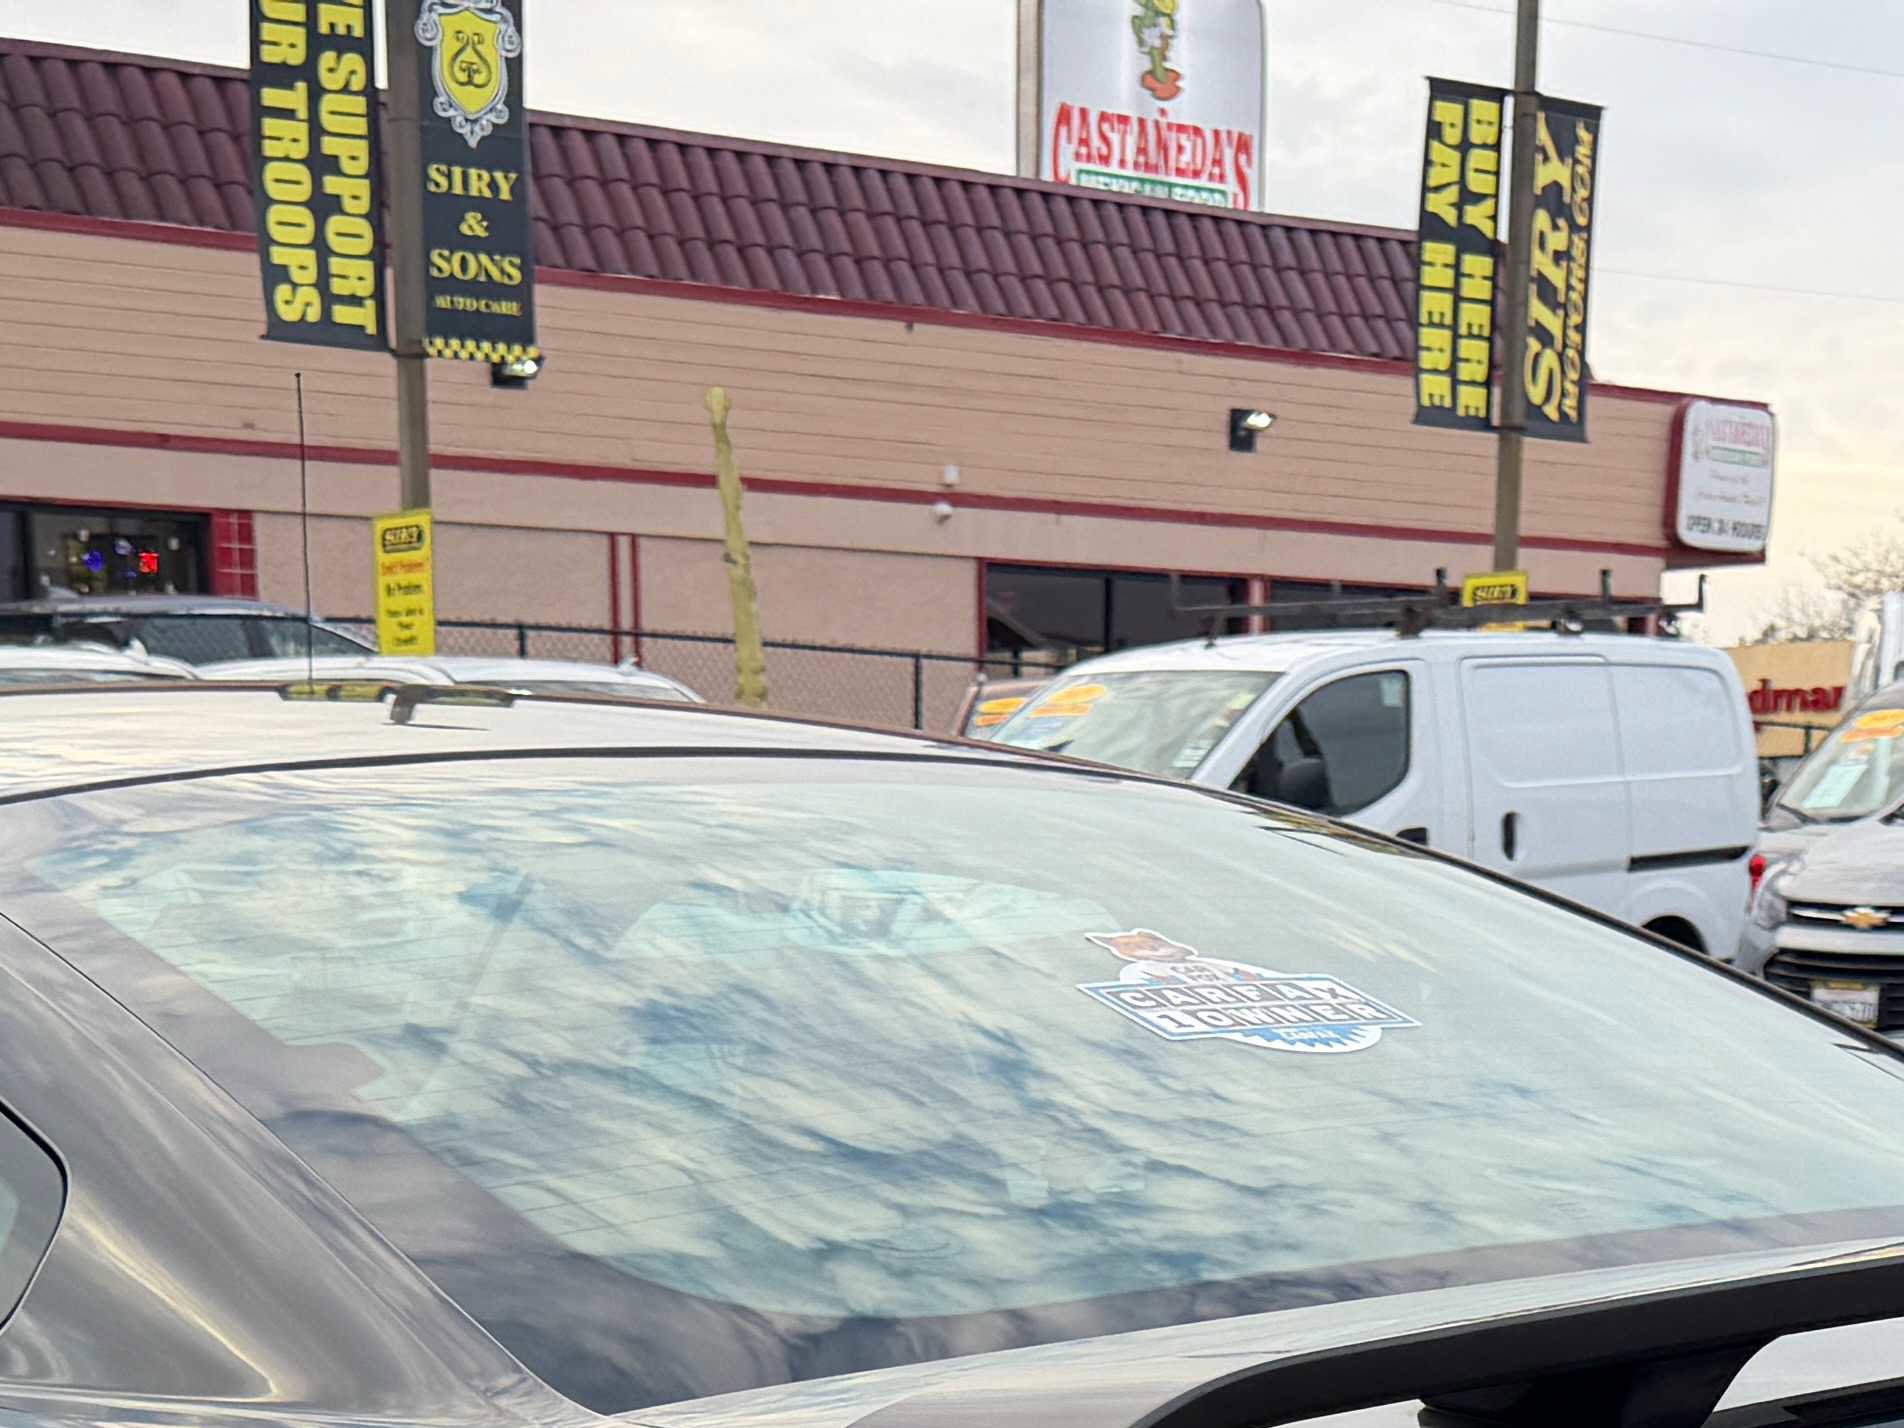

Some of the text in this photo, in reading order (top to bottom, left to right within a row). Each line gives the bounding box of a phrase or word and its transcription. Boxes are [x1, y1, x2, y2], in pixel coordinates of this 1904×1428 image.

[260, 82, 322, 324] TROOPS
[317, 0, 377, 336] E SUPPORT
[427, 163, 519, 201] SIRY
[459, 212, 490, 238] &
[430, 248, 523, 286] SONS
[1419, 100, 1464, 409] PAY HERE
[1456, 98, 1500, 419] BUY HERE
[1524, 110, 1573, 424] SIRY
[1119, 983, 1356, 1009] CARFAX
[1197, 1002, 1394, 1028] OWNER
